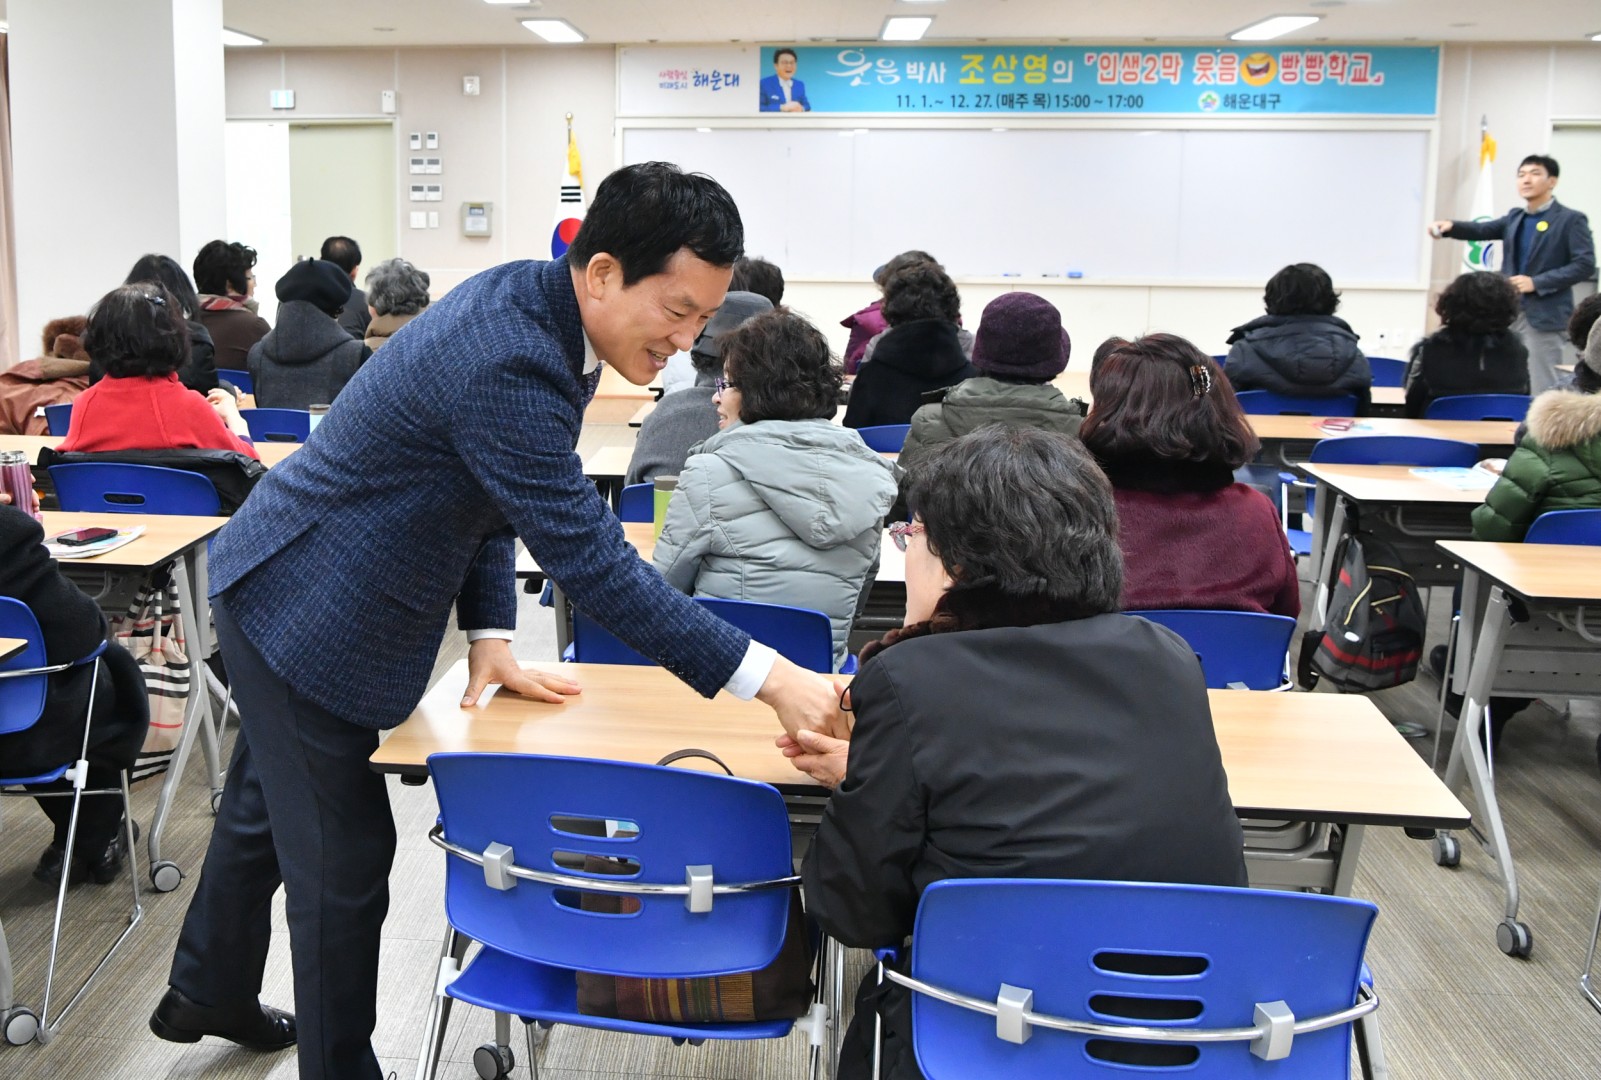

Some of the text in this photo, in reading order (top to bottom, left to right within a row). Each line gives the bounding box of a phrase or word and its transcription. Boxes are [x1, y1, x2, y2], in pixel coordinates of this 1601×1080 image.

[826, 48, 901, 87] 웃음
[905, 61, 946, 84] 박사
[1193, 52, 1241, 86] 웃음
[692, 69, 740, 91] 해운대
[1107, 94, 1144, 109] 17:00
[1223, 93, 1281, 110] 해운대구
